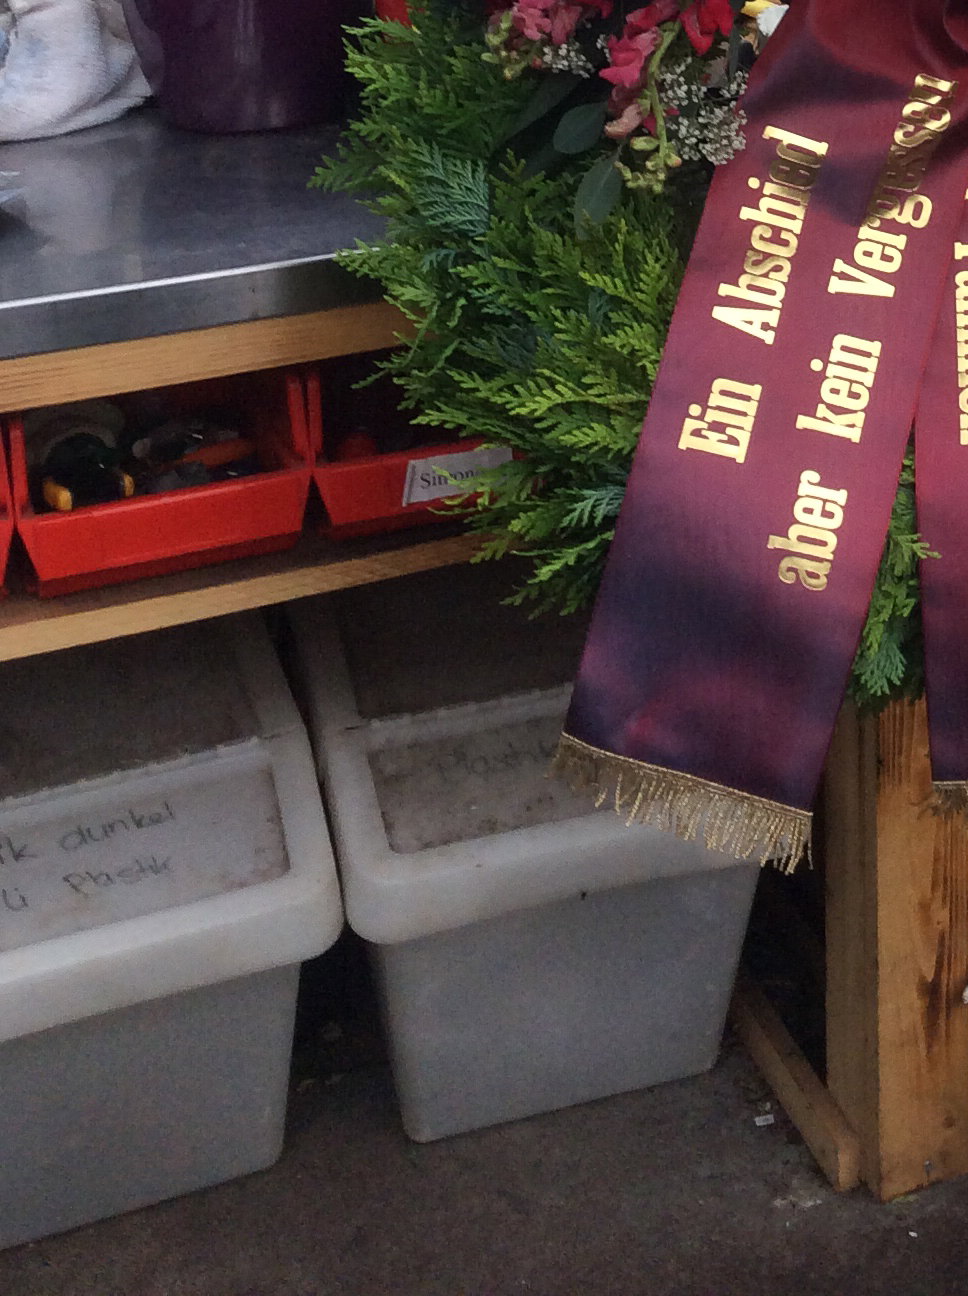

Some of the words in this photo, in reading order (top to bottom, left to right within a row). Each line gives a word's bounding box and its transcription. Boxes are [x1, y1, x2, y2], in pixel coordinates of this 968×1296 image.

[711, 125, 829, 345] Abschied
[828, 72, 959, 298] Vergessen
[677, 377, 763, 464] Ein
[795, 333, 882, 444] kein
[420, 467, 484, 490] Simon
[766, 469, 848, 592] aber
